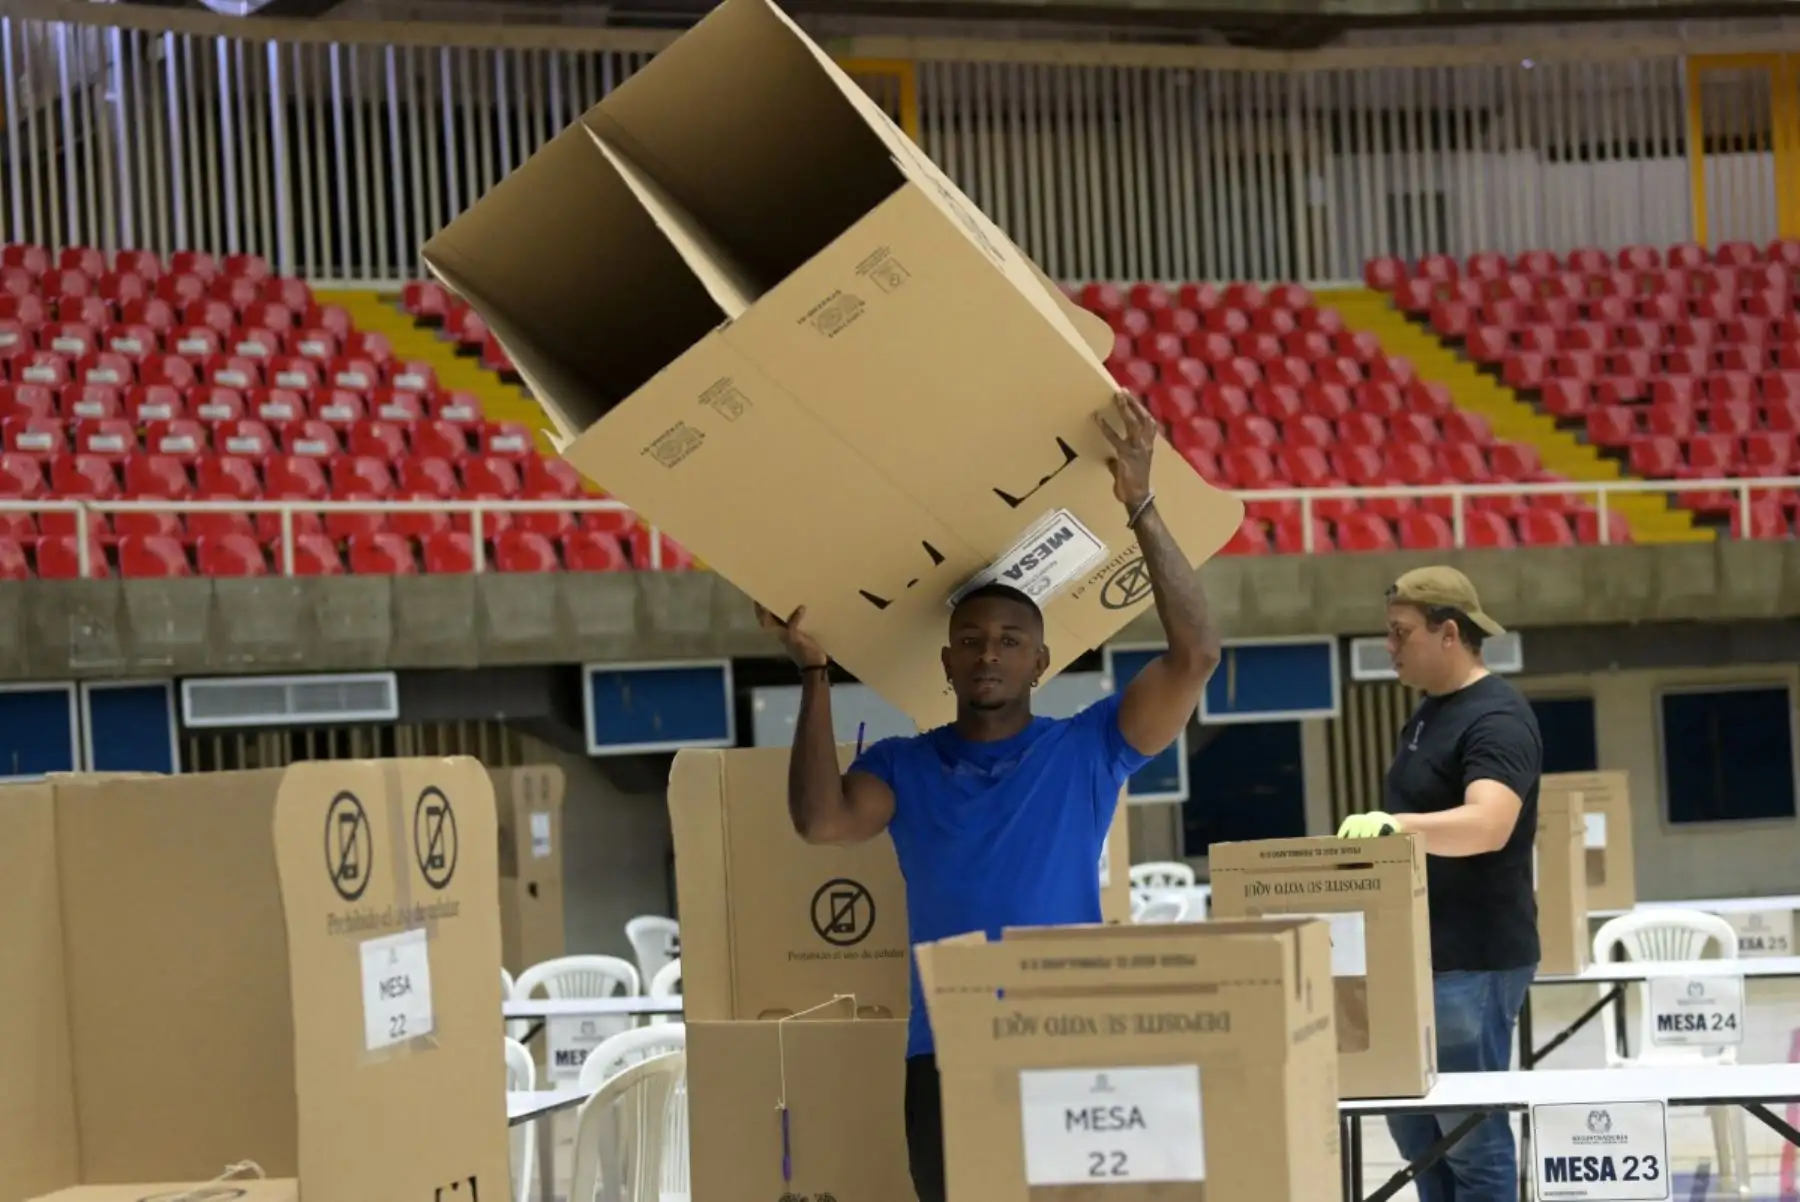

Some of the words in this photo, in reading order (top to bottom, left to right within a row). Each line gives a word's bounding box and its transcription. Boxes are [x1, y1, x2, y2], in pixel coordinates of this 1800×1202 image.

[1002, 526, 1075, 580] MESA
[1273, 881, 1305, 895] VOTO
[1324, 879, 1381, 893] DEPOSITE
[1738, 936, 1765, 950] ESA
[379, 973, 412, 1001] MESA
[388, 1013, 407, 1038] 22
[1044, 1013, 1099, 1037] VOTO
[1657, 1012, 1708, 1032] MESA
[1711, 1012, 1737, 1031] 24
[555, 1048, 588, 1067] MES
[1064, 1104, 1147, 1133] MESA
[1087, 1150, 1130, 1177] 22
[1543, 1155, 1618, 1182] MESA
[1621, 1154, 1660, 1181] 23
